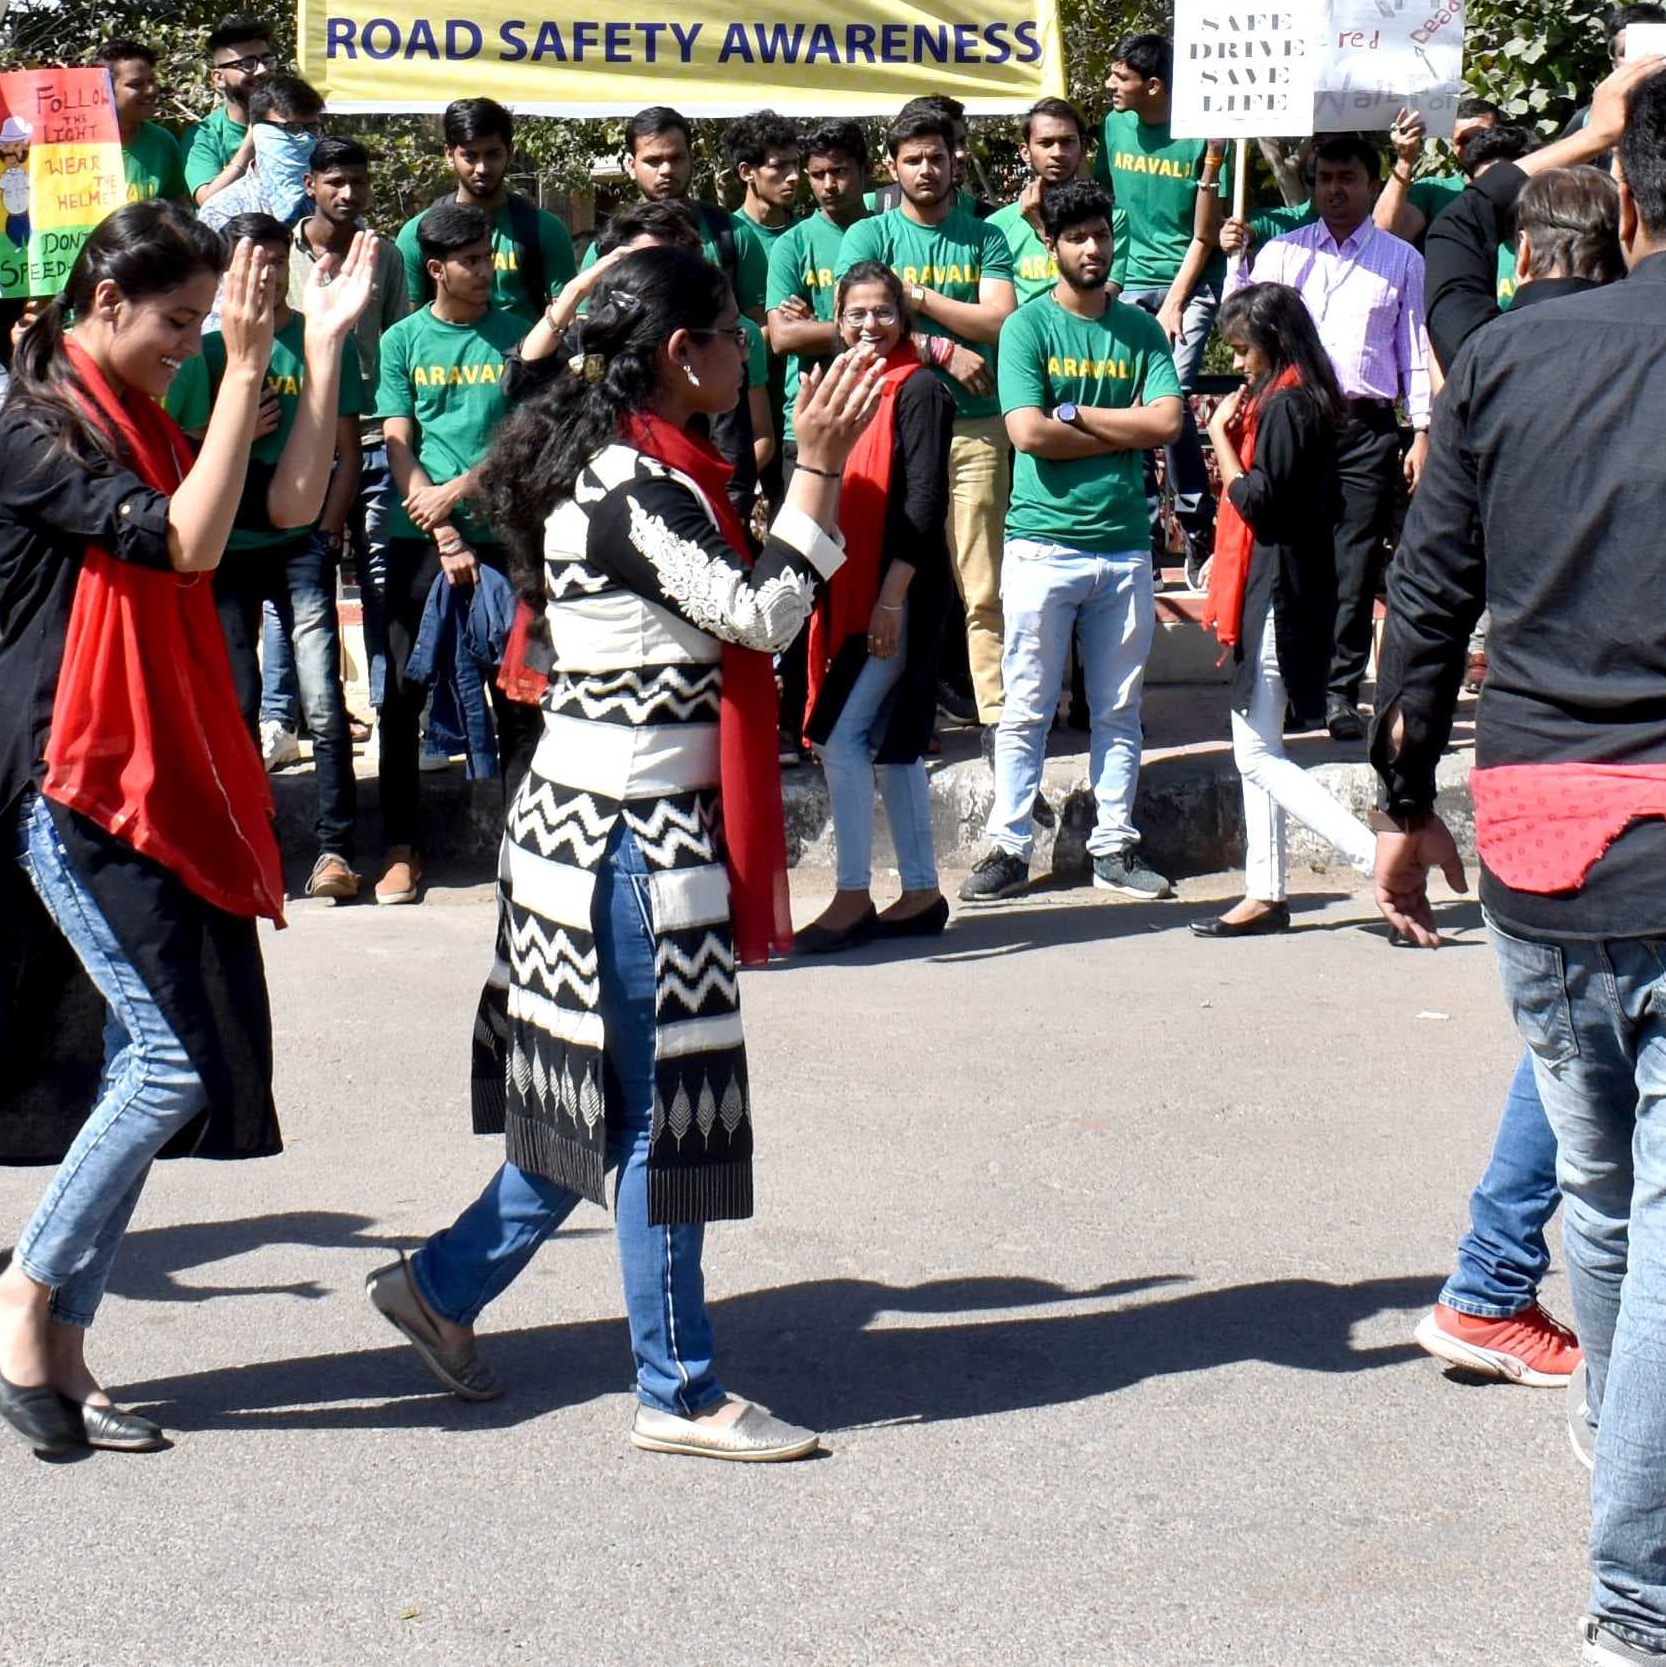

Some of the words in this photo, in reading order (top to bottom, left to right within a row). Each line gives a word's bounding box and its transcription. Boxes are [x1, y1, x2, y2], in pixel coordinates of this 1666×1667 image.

[1201, 14, 1291, 32] SAFE
[326, 18, 484, 63] ROAD
[499, 21, 703, 63] SAFETY
[718, 20, 1042, 64] AWARENESS
[1190, 39, 1305, 60] DRIVE
[1201, 66, 1289, 85] SAVE
[1203, 94, 1288, 112] LIFE
[44, 125, 97, 144] LIGHT
[45, 156, 102, 176] WEAR
[1114, 152, 1191, 178] ARAVALI
[893, 264, 980, 285] RAVALI
